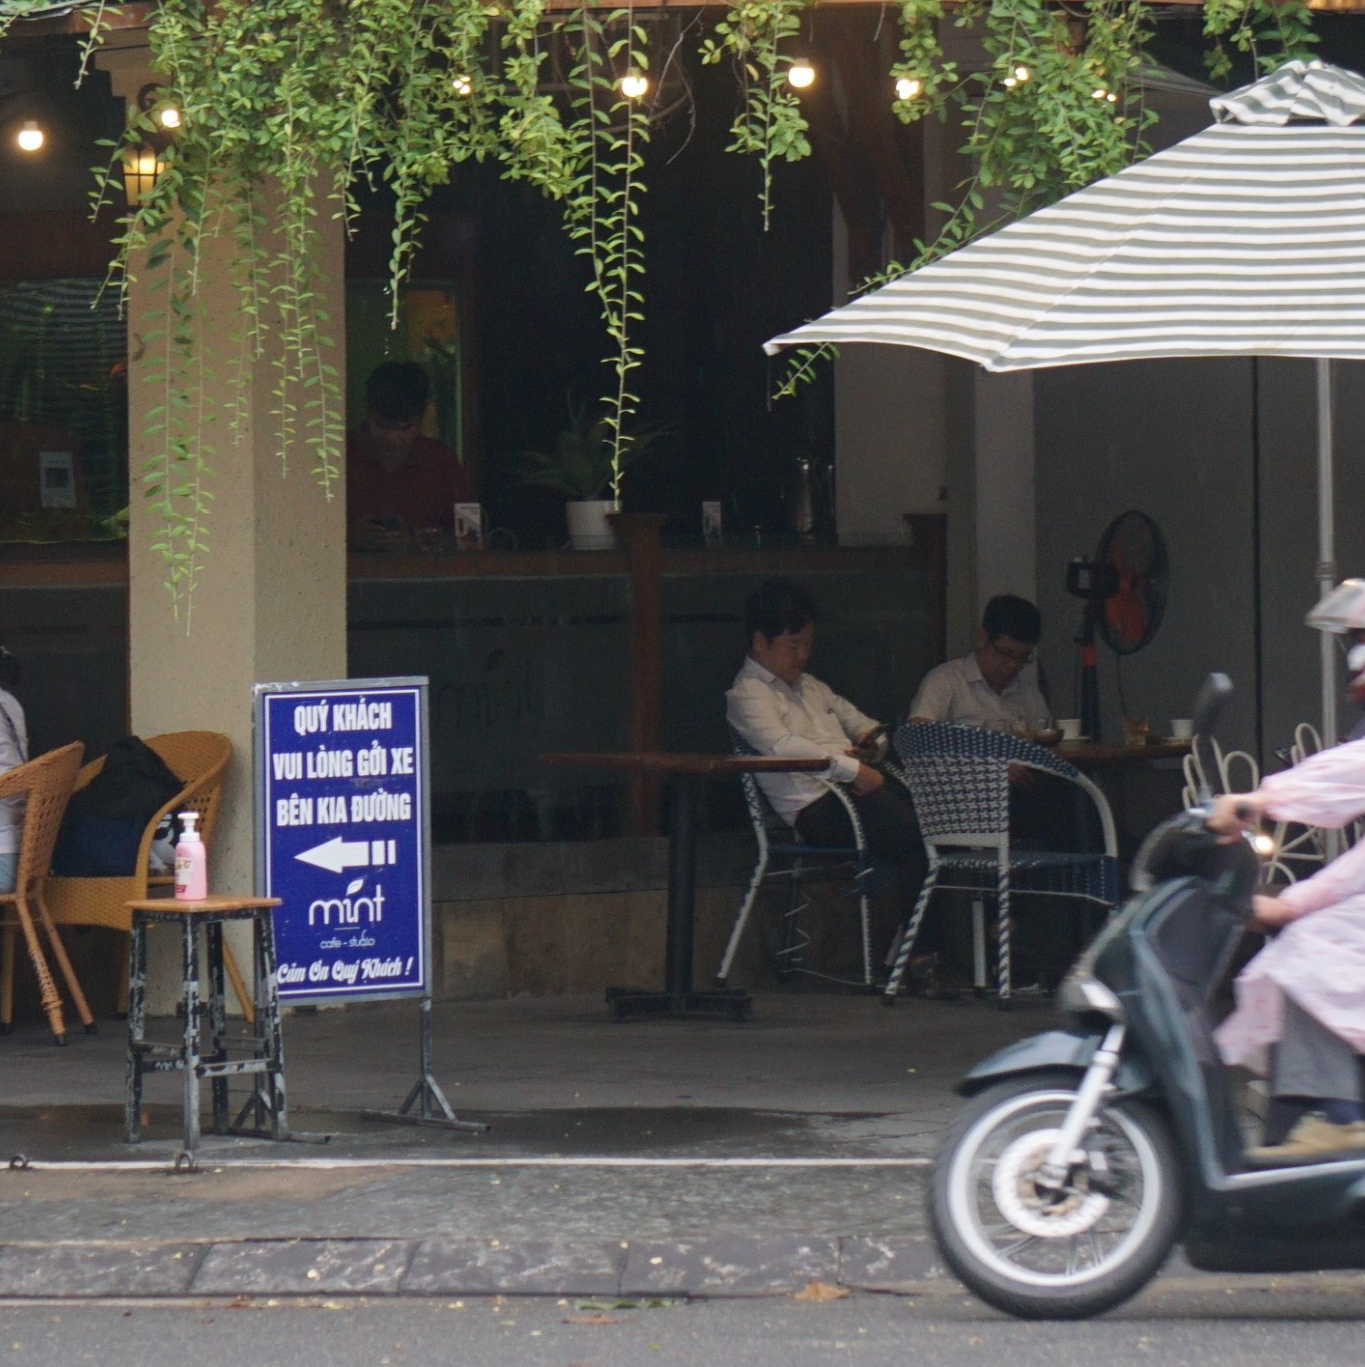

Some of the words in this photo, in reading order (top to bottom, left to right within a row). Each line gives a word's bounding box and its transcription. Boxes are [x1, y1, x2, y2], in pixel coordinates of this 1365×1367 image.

[294, 698, 329, 736] QUÝ
[332, 696, 393, 732] KHÁCH
[273, 752, 303, 780] VUI
[306, 744, 354, 779] LÒNG
[390, 747, 415, 775] XE
[276, 792, 314, 827] BÊN
[316, 795, 348, 824] KIA
[350, 787, 412, 823] ĐƯỜNG
[308, 883, 386, 926] mint
[361, 955, 403, 980] Khách
